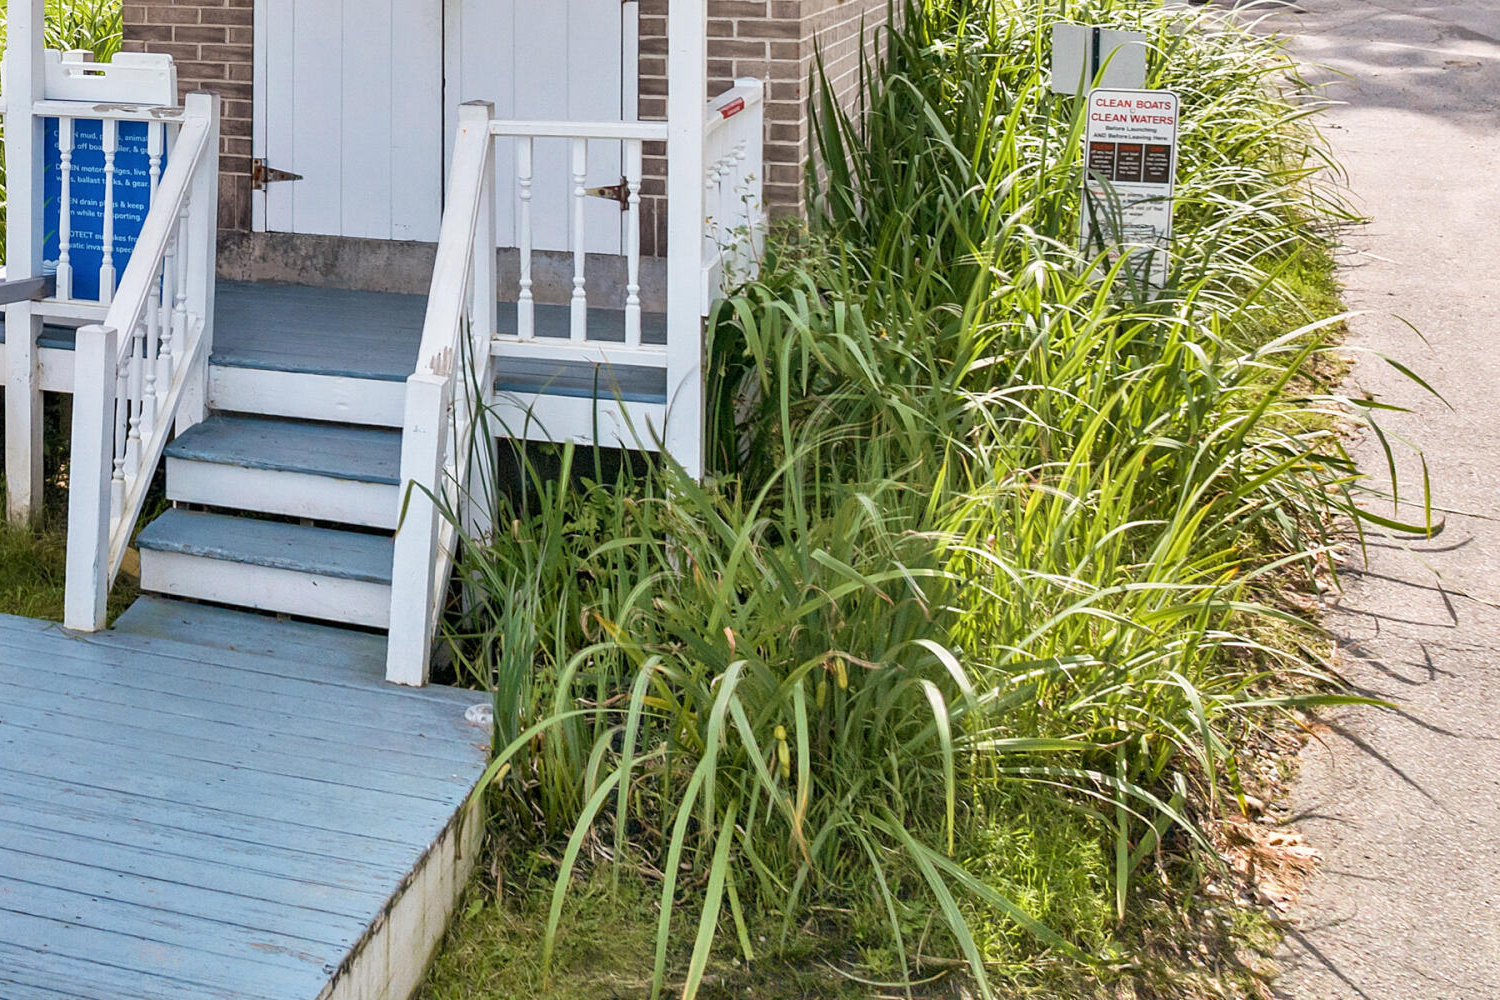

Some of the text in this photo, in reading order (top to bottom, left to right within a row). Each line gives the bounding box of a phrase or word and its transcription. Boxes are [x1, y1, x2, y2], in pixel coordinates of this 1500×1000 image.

[1095, 98, 1172, 110] CLEAN BOATS
[1091, 112, 1174, 125] CLEAN WATERS
[80, 131, 98, 140] mud,
[124, 134, 149, 142] animal
[134, 168, 146, 176] live
[77, 176, 101, 185] ballast
[79, 198, 98, 207] drain
[127, 200, 144, 210] keep
[76, 209, 96, 217] while
